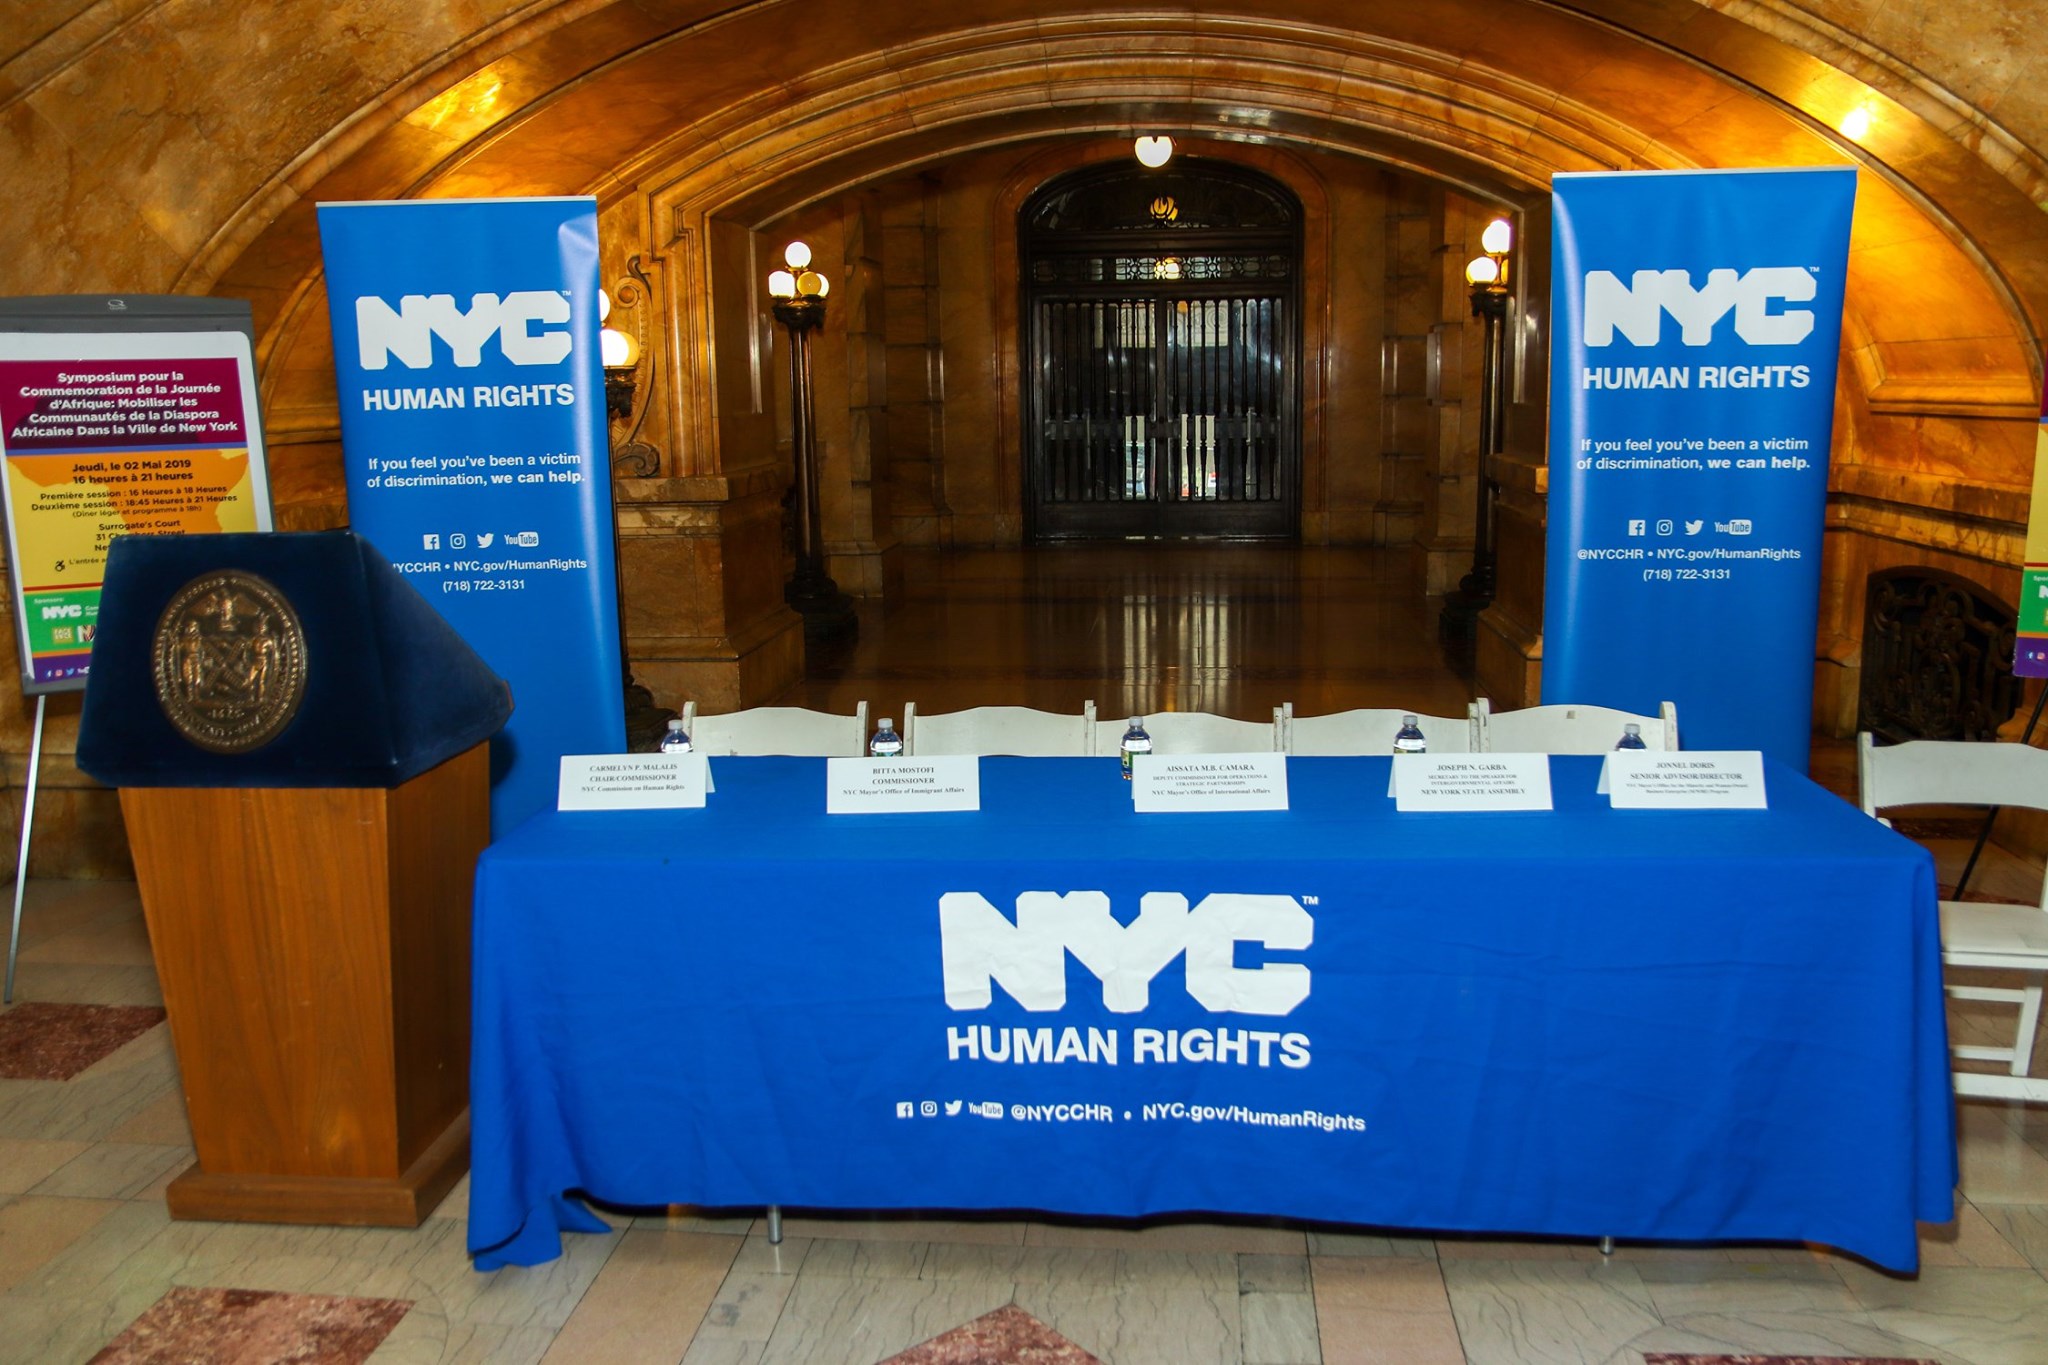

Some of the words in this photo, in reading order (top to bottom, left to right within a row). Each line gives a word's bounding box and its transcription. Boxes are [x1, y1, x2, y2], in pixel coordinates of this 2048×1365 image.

[1584, 267, 1817, 347] NYC
[355, 290, 573, 370] NYC
[58, 373, 136, 384] Symposium
[139, 372, 169, 383] pour
[172, 371, 183, 381] la
[1583, 366, 1689, 389] HUMAN
[1698, 365, 1811, 388] RIGHTS
[20, 386, 133, 397] Commemoration
[136, 385, 152, 395] de
[156, 385, 167, 394] la
[171, 383, 221, 394] Journée
[363, 386, 465, 411] HUMAN
[474, 383, 575, 408] RIGHTS
[118, 397, 176, 408] Mobiliser
[179, 397, 198, 406] les
[29, 411, 126, 423] Communautés
[130, 411, 145, 421] de
[149, 411, 160, 420] la
[164, 409, 219, 421] Diaspora
[12, 426, 74, 437] Africaine
[77, 425, 110, 435] Dans
[113, 425, 125, 434] la
[127, 423, 157, 434] Ville
[160, 423, 176, 433] de
[179, 422, 206, 432] New
[209, 421, 238, 431] York
[1581, 438, 1591, 451] If
[1595, 441, 1621, 454] you
[1624, 438, 1652, 451] feel
[1656, 438, 1704, 453] you've
[1708, 438, 1745, 450] been
[1749, 440, 1759, 450] a
[1763, 437, 1809, 450] victim
[72, 462, 108, 473] Jeudi,
[110, 461, 121, 471] le
[124, 461, 139, 470] 02
[142, 460, 161, 470] Mai
[165, 459, 191, 469] 2019
[369, 458, 378, 470] If
[381, 459, 407, 472] you
[411, 456, 437, 469] feel
[440, 455, 486, 471] you've
[489, 454, 524, 466] been
[527, 456, 536, 465] a
[539, 452, 581, 465] victim
[1577, 457, 1592, 470] of
[1596, 456, 1703, 471] discrimination,
[1707, 459, 1731, 469] we
[1736, 458, 1766, 469] can
[1771, 456, 1810, 471] help.
[73, 475, 86, 484] 16
[89, 473, 128, 483] heures
[131, 472, 138, 482] à
[141, 473, 152, 482] 21
[155, 471, 193, 481] heures
[367, 475, 381, 488] of
[384, 473, 488, 488] discrimination,
[491, 474, 513, 484] we
[517, 473, 544, 483] can
[548, 470, 585, 485] help.
[40, 491, 84, 500] Première
[86, 490, 121, 499] session
[129, 488, 139, 497] 16
[142, 487, 174, 496] Heures
[176, 486, 182, 495] à
[184, 486, 194, 494] 18
[196, 485, 227, 494] Heures
[31, 501, 80, 511] Deuxième
[83, 500, 117, 509] session
[126, 498, 150, 507] 18:45
[153, 496, 185, 505] Heures
[187, 495, 193, 504] à
[195, 495, 204, 503] 21
[206, 494, 238, 503] Heures
[99, 508, 120, 518] léger
[122, 508, 131, 516] et
[132, 506, 177, 516] programme
[155, 519, 181, 528] Court
[1714, 519, 1752, 535] YouTube
[96, 533, 106, 541] 31
[504, 531, 539, 548] YouTube
[1577, 549, 1644, 561] @NYCCHR
[1657, 547, 1801, 561] NYC.gov/HumanRights
[394, 562, 442, 574] YCCHR
[453, 558, 588, 573] NYC.gov/HumanRights
[1643, 569, 1673, 581] (718)
[1676, 568, 1731, 580] 722-3131
[443, 580, 471, 593] (718)
[474, 579, 526, 591] 722-3131
[42, 605, 82, 619] NYC
[589, 764, 634, 772] CARMELYN
[643, 763, 678, 771] MALALIS
[1219, 764, 1255, 772] CAMARA
[1437, 764, 1468, 772] JOSEPH
[589, 774, 677, 782] CHAIR/COMMISSIONER
[872, 777, 935, 785] COMMISSIONER
[911, 787, 942, 795] Immigrant
[939, 890, 1314, 1016] NYC
[946, 1024, 1118, 1066] HUMAN
[1133, 1027, 1311, 1069] RIGHTS
[968, 1100, 1004, 1119] YouTube
[1011, 1103, 1113, 1123] @NYCCHR
[1143, 1102, 1366, 1132] NYC.gov/HumanRights
